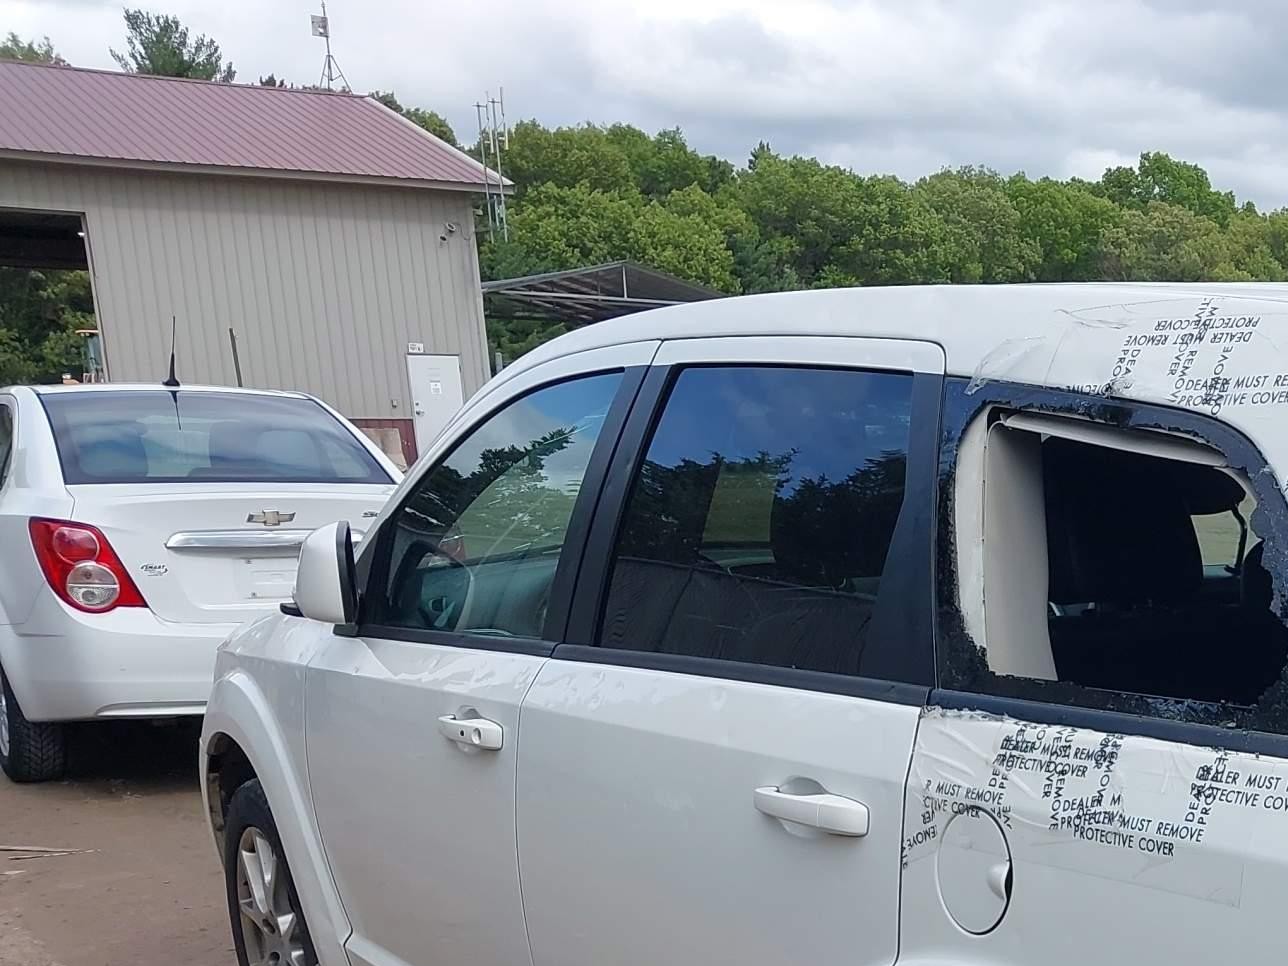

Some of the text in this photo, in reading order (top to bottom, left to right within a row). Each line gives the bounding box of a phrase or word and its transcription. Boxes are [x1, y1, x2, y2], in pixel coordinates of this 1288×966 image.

[1154, 318, 1191, 331] COVER
[1123, 334, 1170, 346] REMOVE
[1210, 331, 1253, 344] DEALER
[1233, 375, 1270, 389] MUST
[1245, 773, 1282, 790] MUST
[935, 781, 961, 797] MUST
[964, 787, 1005, 805] REMOVE
[951, 801, 981, 818] COVER
[1062, 794, 1103, 812] DEALER
[1119, 814, 1152, 833] MUST
[1156, 821, 1205, 842] REMOVE
[1073, 826, 1175, 857] PROTECTIVE COVER
